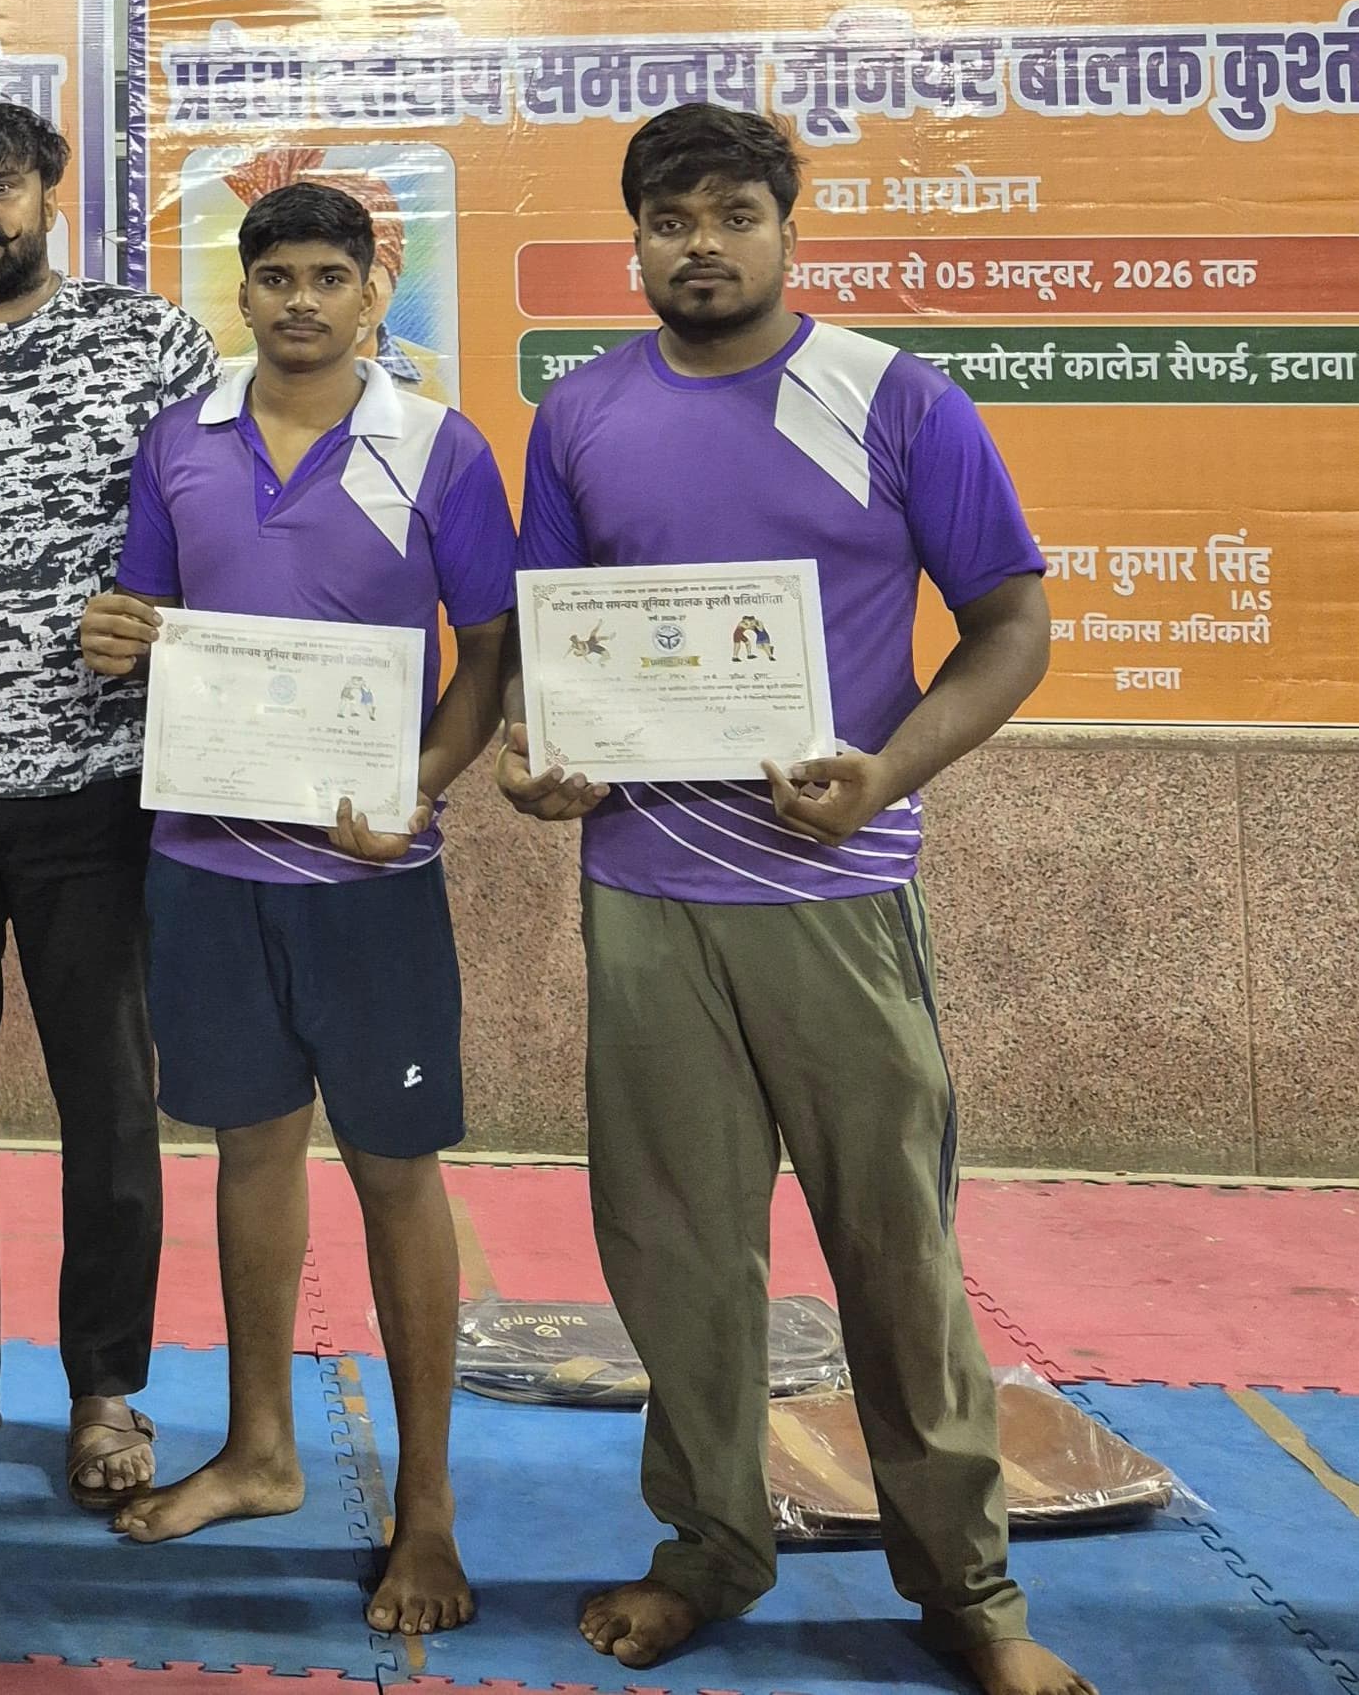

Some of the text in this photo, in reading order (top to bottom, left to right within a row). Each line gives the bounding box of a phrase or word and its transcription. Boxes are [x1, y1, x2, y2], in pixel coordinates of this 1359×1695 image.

[1011, 33, 1206, 109] बालक
[812, 165, 1042, 214] का आयोजन
[786, 253, 1258, 302] अक्टूबर से 05 अक्टूबर, 2026 तक
[1061, 342, 1161, 381] कालेज
[1167, 340, 1259, 385] सैफई,
[1268, 352, 1358, 381] इटावा
[1106, 546, 1198, 596] कुमार
[1205, 528, 1273, 585] सिंह
[552, 598, 574, 612] प्रदेश
[576, 598, 604, 612] स्तरीय
[605, 600, 639, 610] समन्वय
[641, 596, 671, 612] जूनियर
[705, 594, 732, 611] कुश्ती
[733, 592, 784, 607] प्रतियोगिता
[1230, 590, 1272, 611] IAS
[1082, 612, 1162, 643] विकास
[1169, 613, 1271, 644] अधिकारी
[1113, 667, 1183, 691] इटावा
